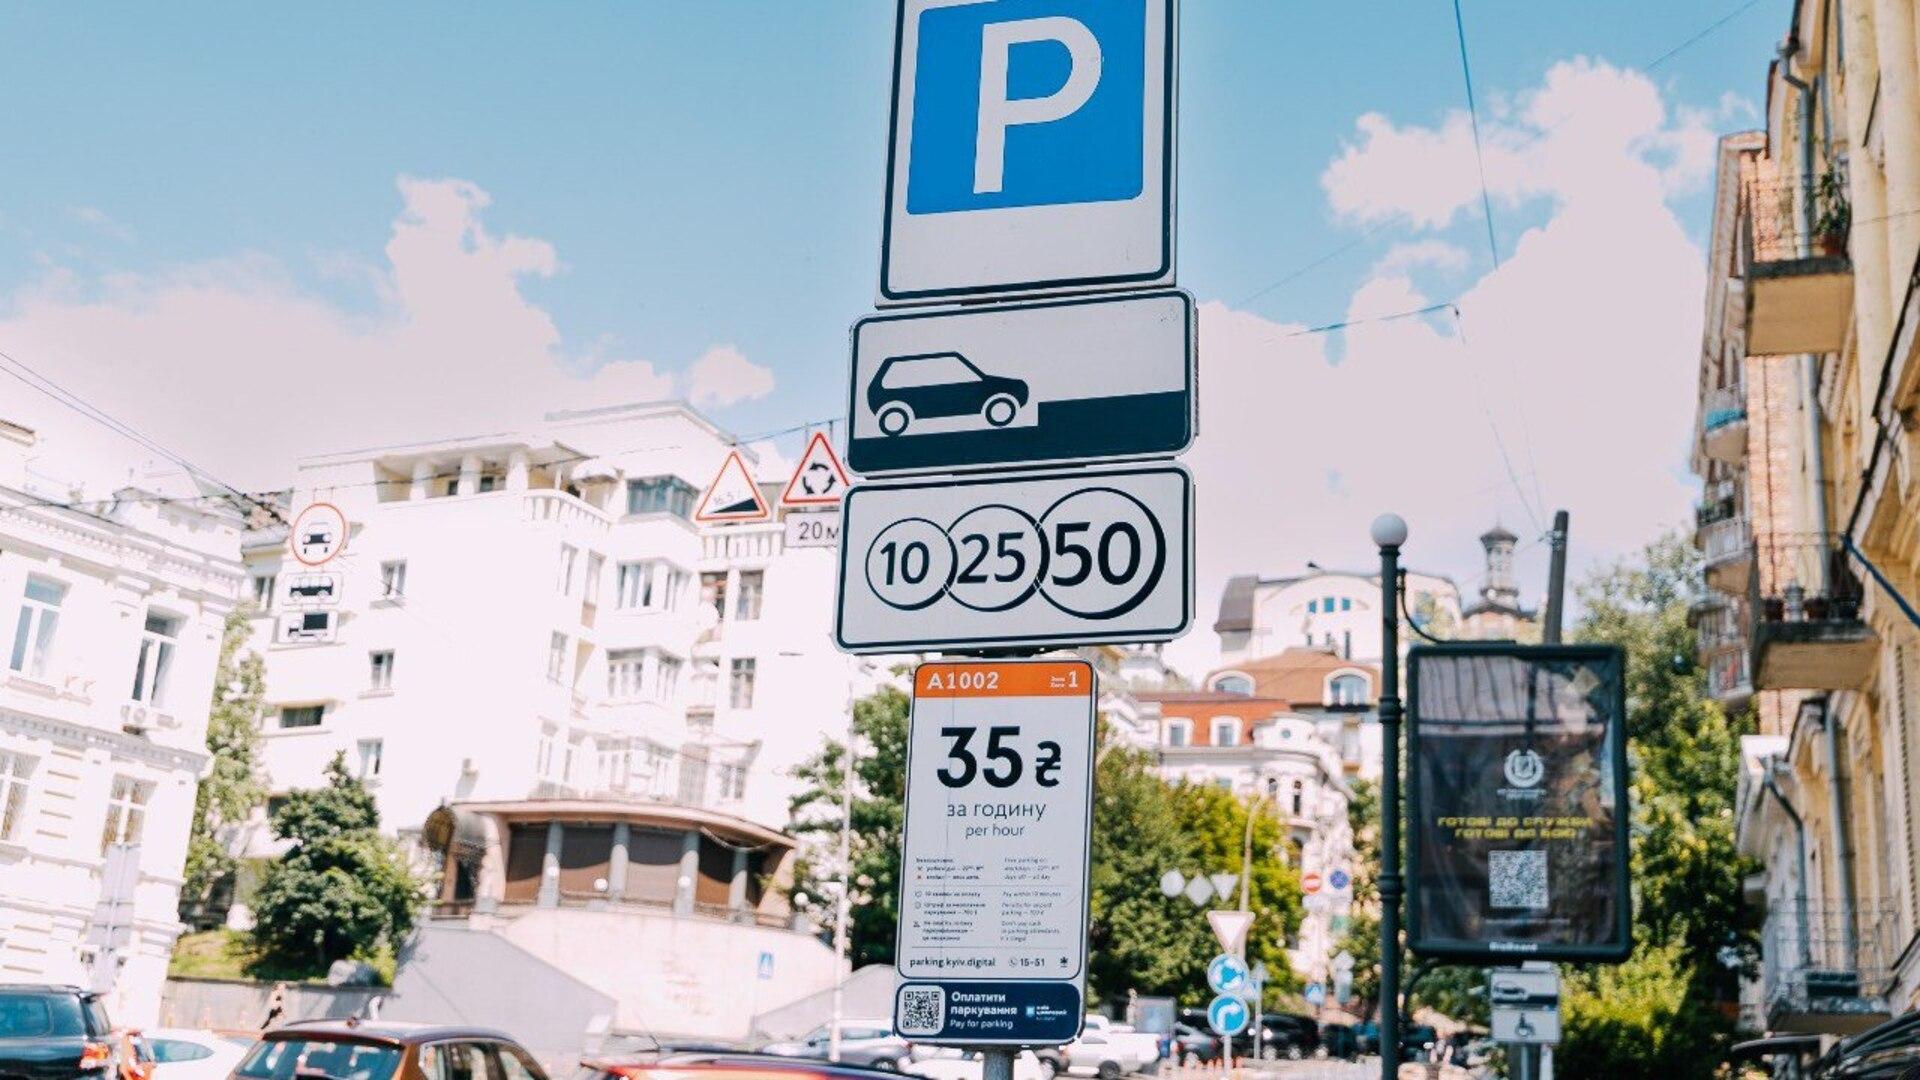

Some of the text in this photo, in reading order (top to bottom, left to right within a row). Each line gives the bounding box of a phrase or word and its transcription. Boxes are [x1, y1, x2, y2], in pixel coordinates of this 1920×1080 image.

[973, 16, 1102, 194] P
[798, 522, 822, 540] 20
[880, 521, 1141, 587] 10 25 50
[926, 671, 999, 690] A1002
[1068, 670, 1079, 688] 1
[937, 726, 1023, 788] 35
[947, 804, 1046, 821] за годину
[965, 823, 1025, 839] per hour
[951, 991, 1006, 1002] Оплатити
[950, 1006, 1017, 1018] паркування
[949, 1019, 1013, 1030] Pay for parking
